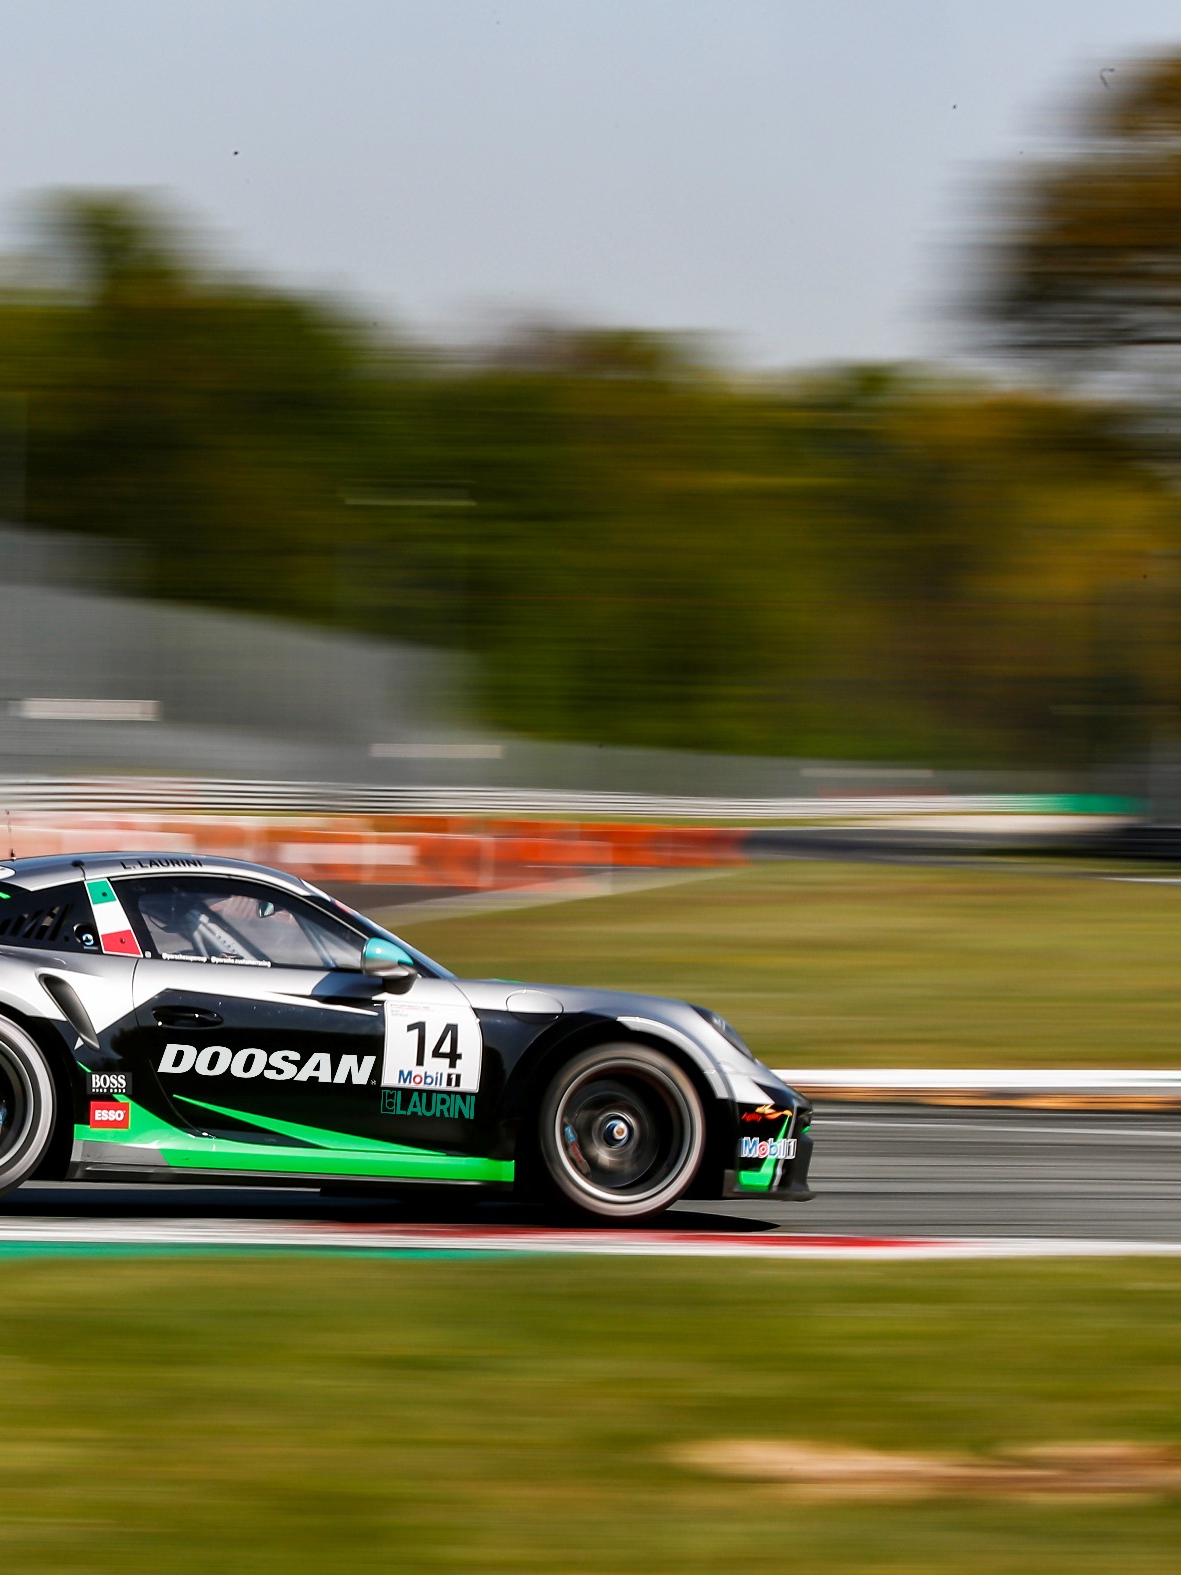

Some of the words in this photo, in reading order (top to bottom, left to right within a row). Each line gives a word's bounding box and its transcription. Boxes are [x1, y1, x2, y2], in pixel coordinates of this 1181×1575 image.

[120, 861, 136, 870] L.
[137, 859, 203, 869] LAURINI
[406, 1020, 463, 1069] 14
[157, 1043, 377, 1085] DOOSAN
[91, 1073, 127, 1089] BOSS
[398, 1069, 444, 1087] Mobil
[447, 1073, 461, 1088] 1
[94, 1109, 125, 1122] ESSO
[395, 1090, 476, 1120] LAURINI
[739, 1136, 786, 1159] Mobil
